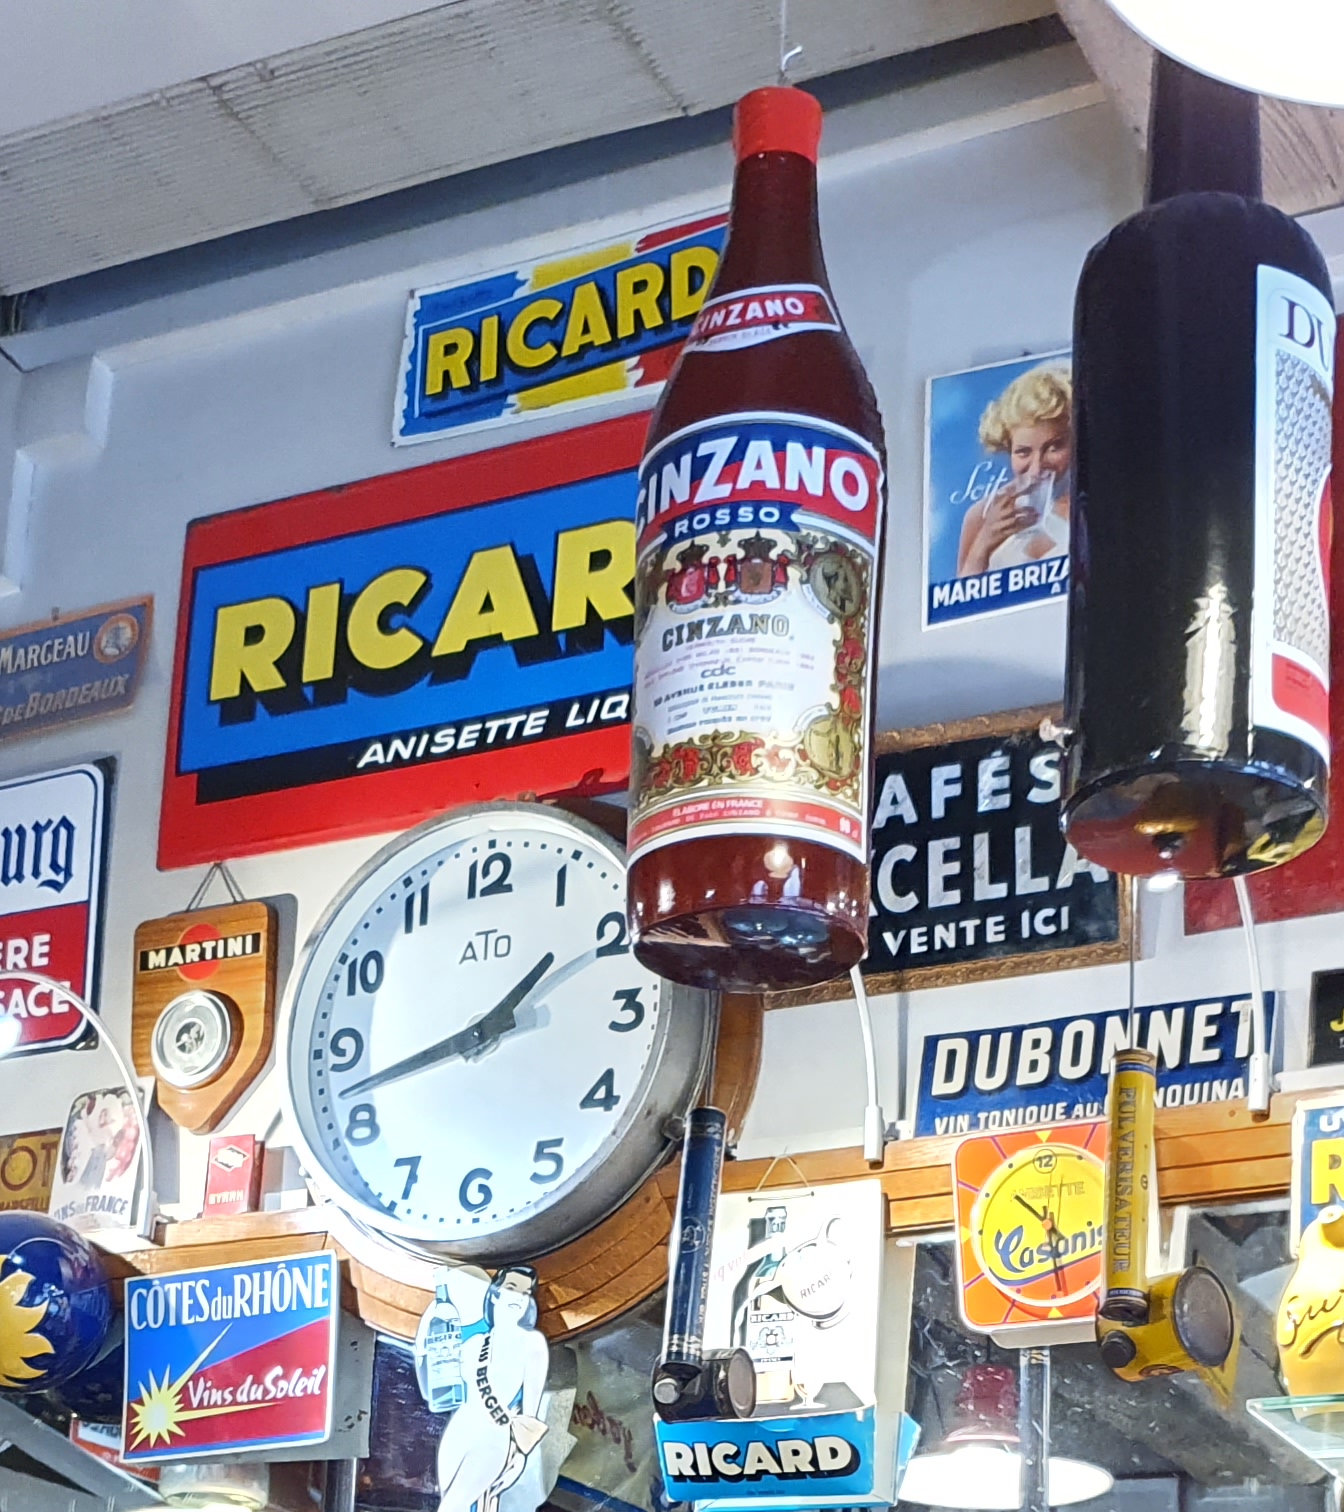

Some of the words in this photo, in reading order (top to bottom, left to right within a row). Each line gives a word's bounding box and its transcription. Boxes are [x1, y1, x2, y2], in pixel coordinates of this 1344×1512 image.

[426, 245, 721, 397] RICARD
[638, 436, 870, 533] INZANO
[674, 507, 781, 537] ROSSO
[210, 518, 635, 703] RICAR
[933, 580, 1001, 608] MARIE
[662, 613, 790, 652] CINZANO
[24, 674, 131, 719] BORDEAUX
[357, 711, 548, 768] ANISETTE
[873, 750, 1062, 829] AFÉS
[468, 852, 513, 899] 12
[556, 865, 567, 907] 1
[869, 825, 1110, 918] CELLA
[404, 883, 430, 935] 11
[883, 916, 1006, 957] VENTE
[1022, 906, 1069, 939] ICI
[147, 935, 254, 968] MARTINI
[596, 913, 630, 958] 2
[347, 949, 384, 997] 10
[609, 989, 645, 1032] 3
[330, 1027, 364, 1074] 9
[931, 1000, 1256, 1097] DUBONNET
[579, 1068, 620, 1113] 4
[345, 1105, 380, 1148] 8
[935, 1116, 969, 1136] VIN
[978, 1102, 1067, 1130] TONIQUE
[1071, 1101, 1099, 1118] AU
[392, 1156, 422, 1201] 7
[534, 1137, 564, 1180] 5
[1037, 1154, 1053, 1167] 12
[1113, 1087, 1136, 1273] PULVERISATEUR
[86, 1196, 128, 1215] FRANCE
[459, 1169, 492, 1213] 6
[130, 1278, 208, 1330] CÔTES
[211, 1288, 234, 1320] du
[234, 1262, 330, 1316] RHÔNE
[188, 1368, 234, 1408] Vins
[237, 1374, 263, 1404] du
[262, 1364, 327, 1400] Soleil
[476, 1366, 511, 1427] BERGER
[664, 1435, 853, 1478] RICARD
